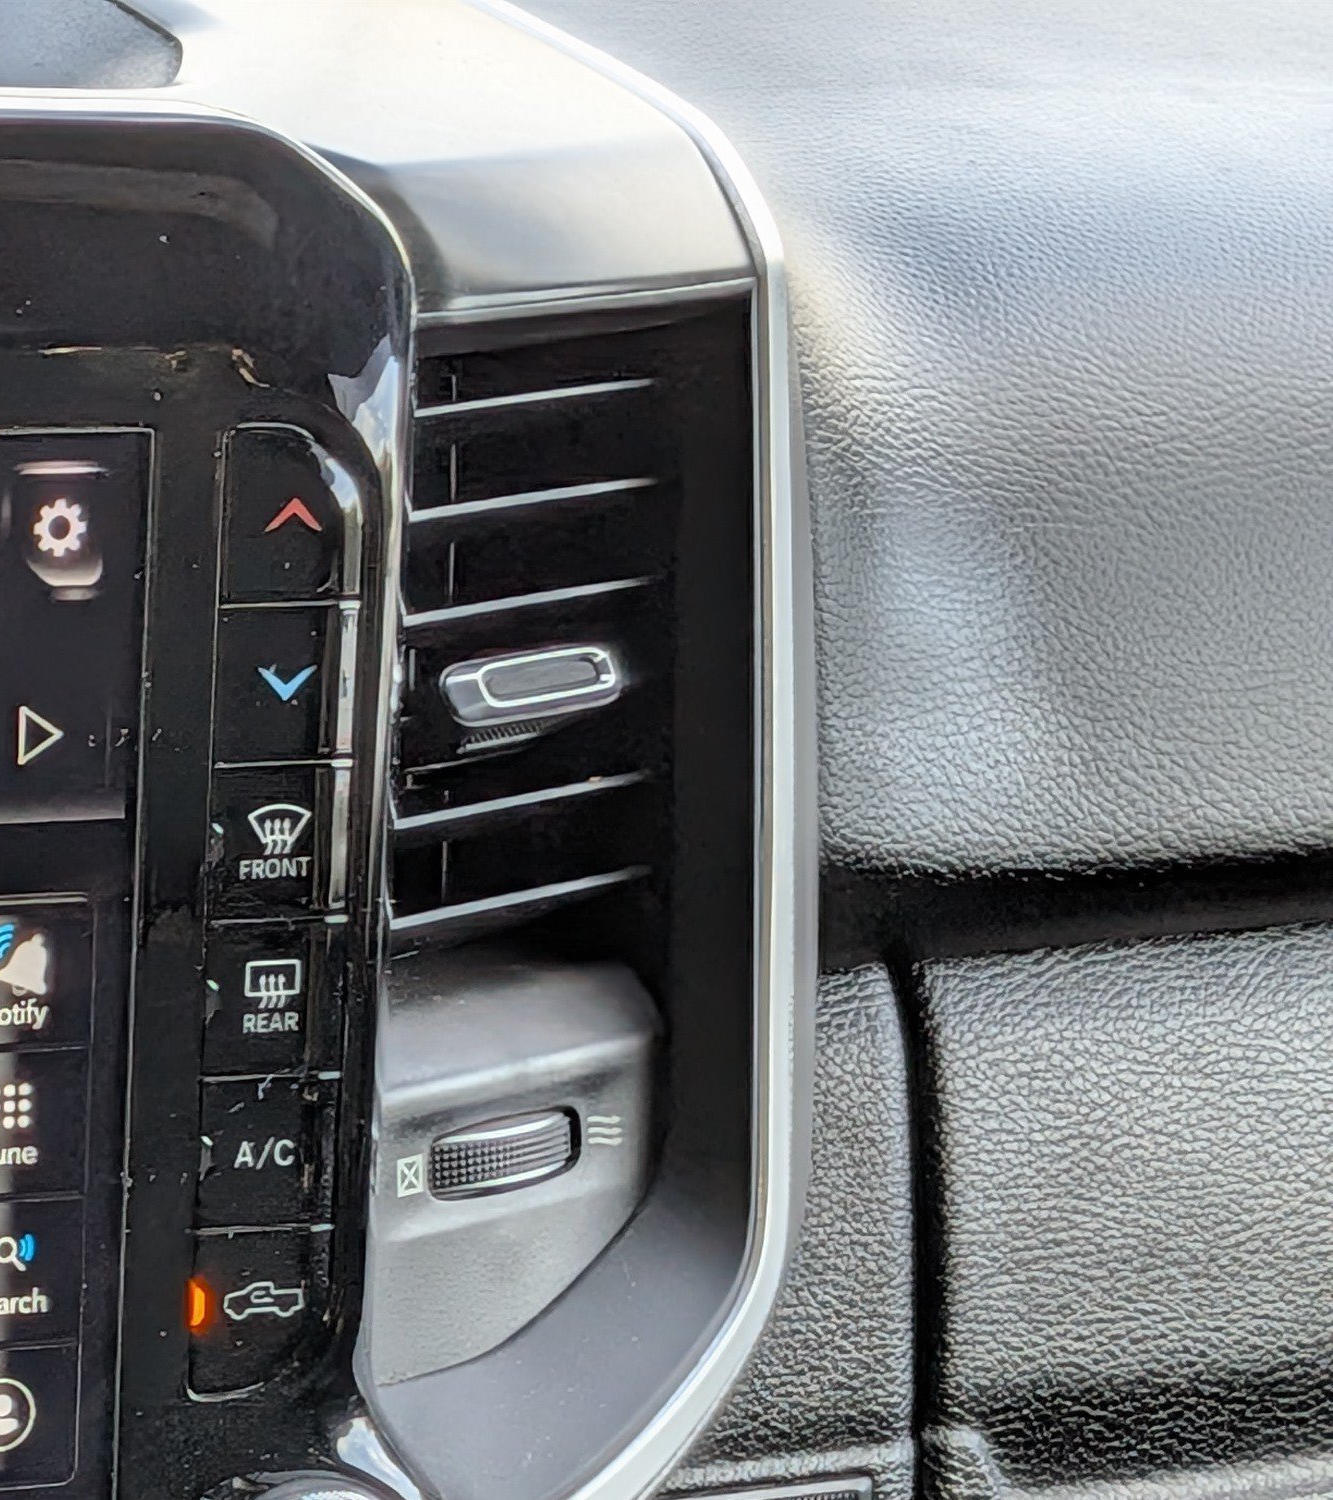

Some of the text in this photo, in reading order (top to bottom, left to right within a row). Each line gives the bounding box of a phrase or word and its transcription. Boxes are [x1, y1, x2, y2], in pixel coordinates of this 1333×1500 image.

[239, 856, 312, 880] FRONT
[242, 1012, 300, 1035] REAR
[234, 1136, 296, 1170] A/C
